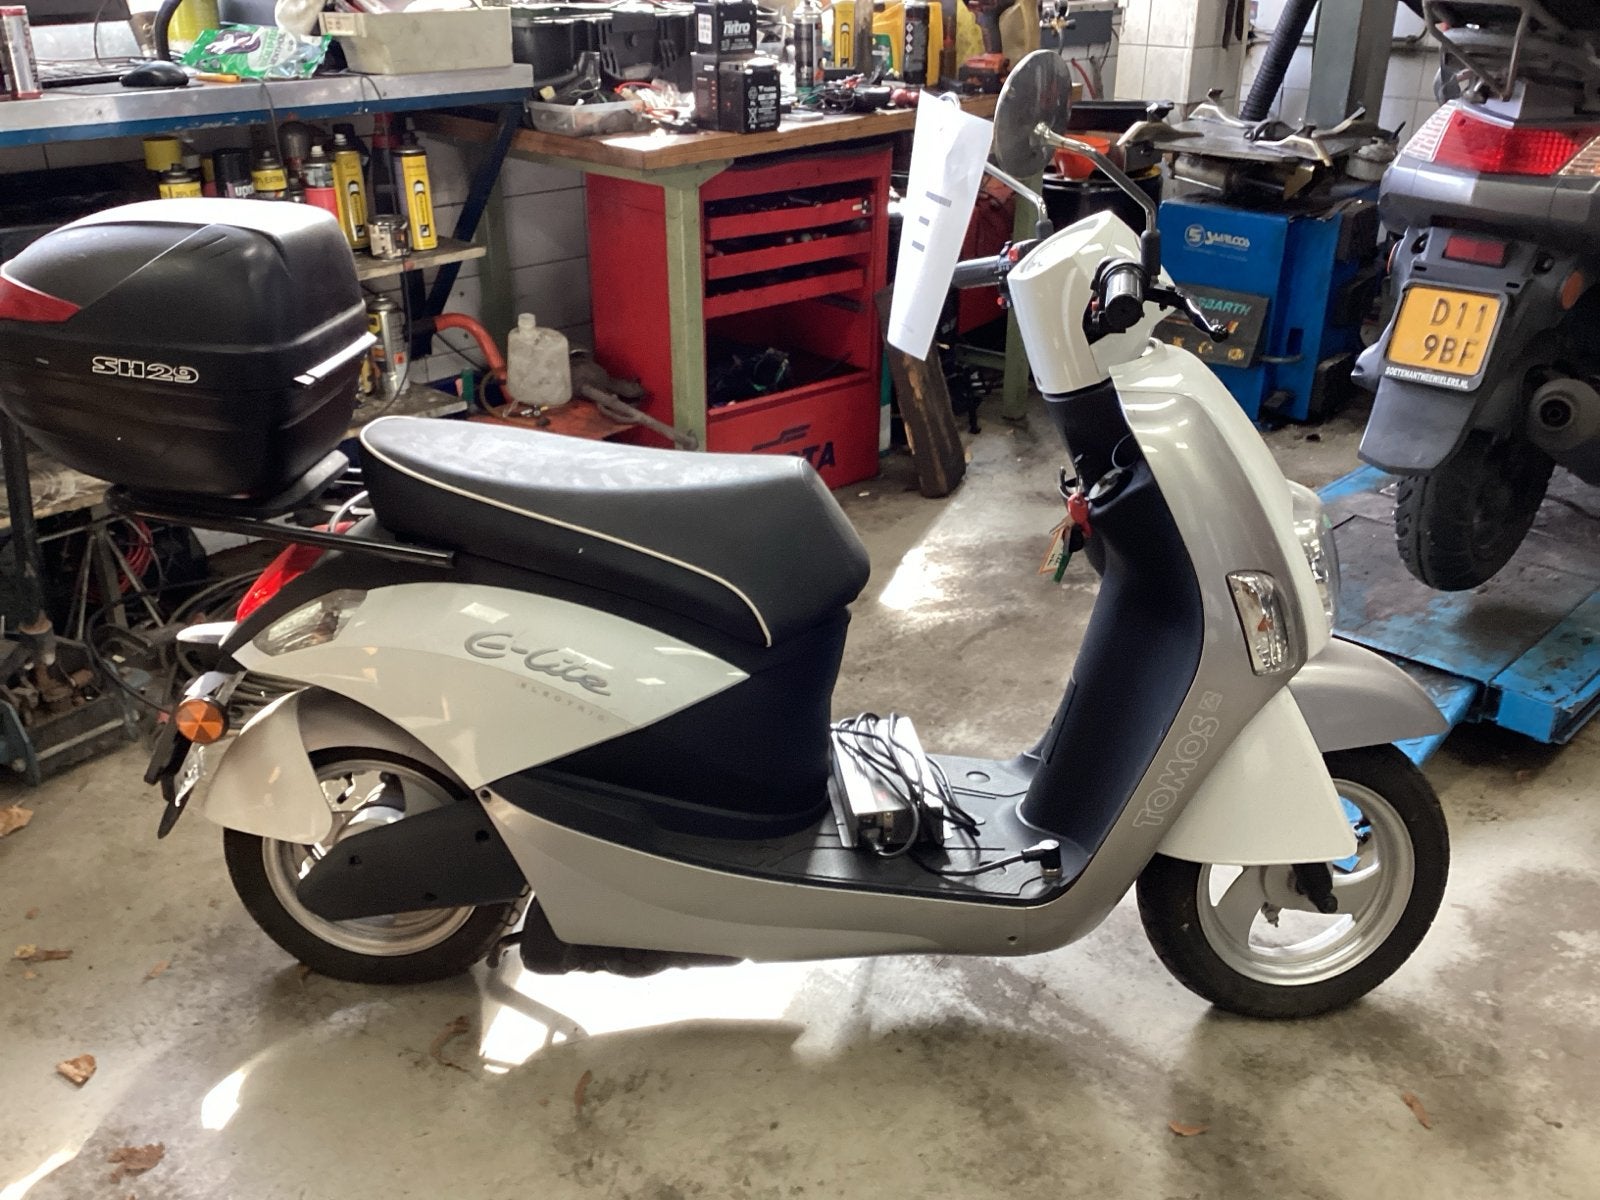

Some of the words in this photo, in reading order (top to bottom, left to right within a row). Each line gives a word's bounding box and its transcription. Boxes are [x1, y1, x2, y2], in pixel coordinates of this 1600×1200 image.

[723, 22, 751, 35] nitro
[1422, 334, 1479, 367] 9BF
[92, 356, 199, 384] SH29
[1132, 715, 1220, 828] TOMOS
